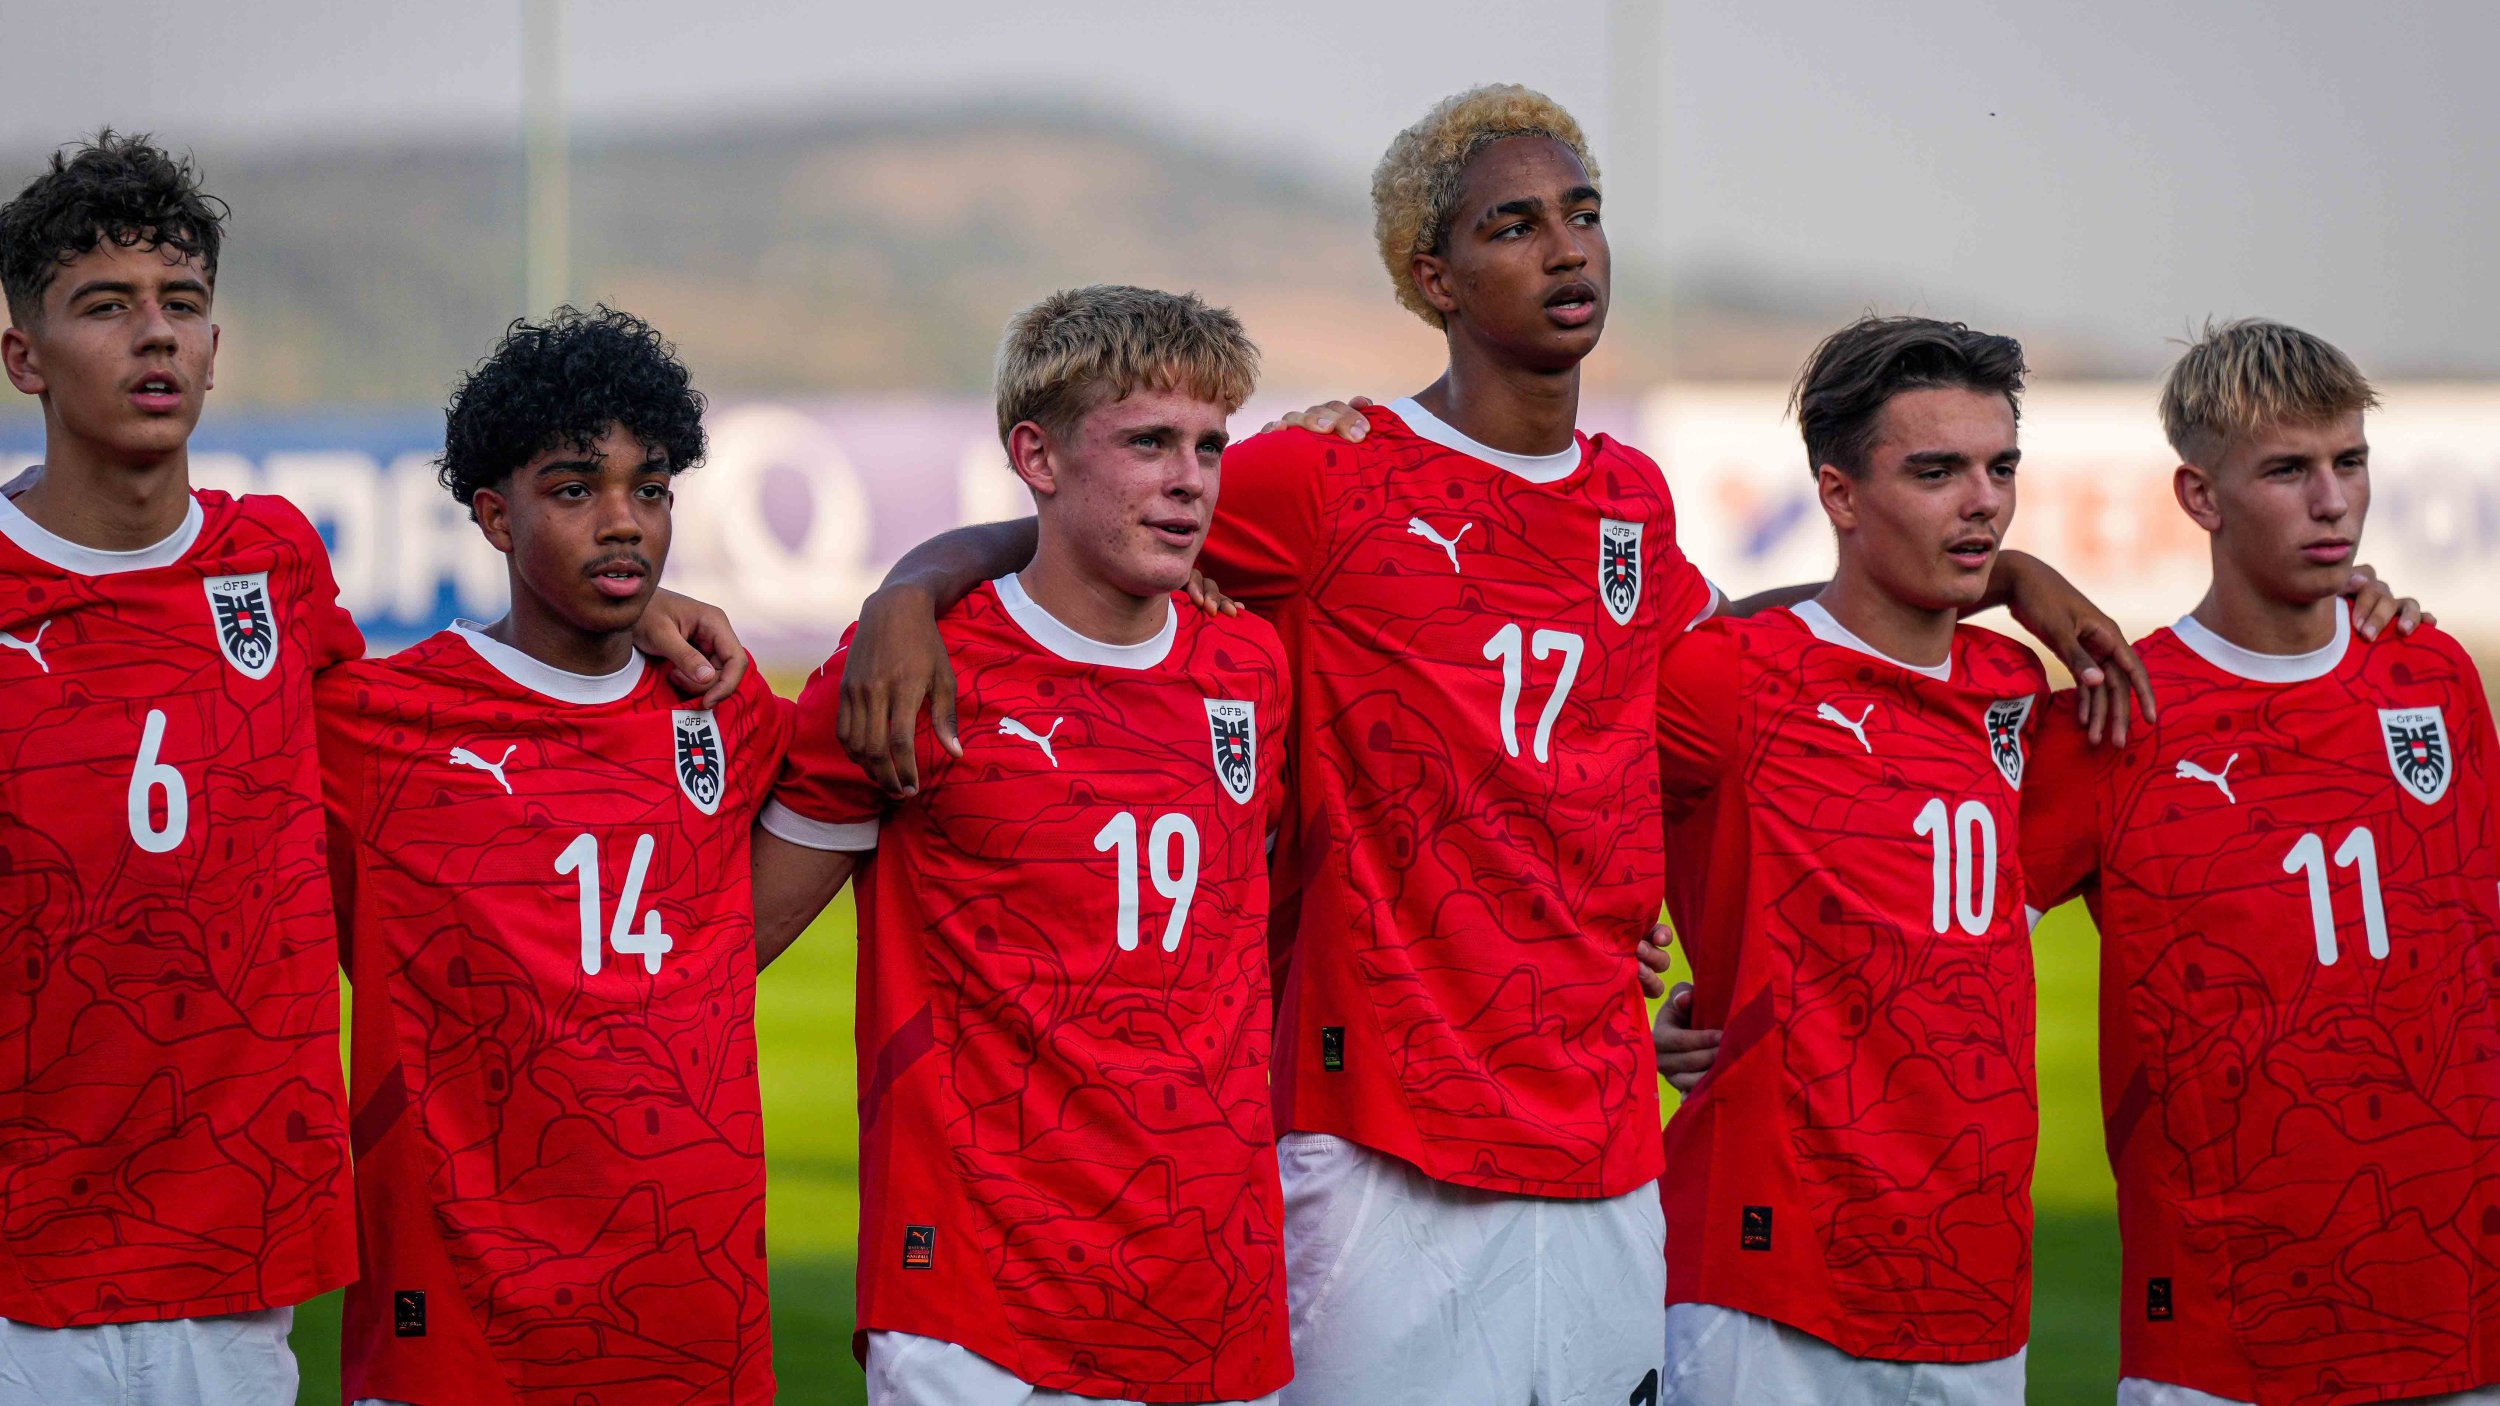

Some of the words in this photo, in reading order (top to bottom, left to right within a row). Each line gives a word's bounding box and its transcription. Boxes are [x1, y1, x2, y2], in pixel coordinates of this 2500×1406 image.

[223, 580, 249, 592] ÖFB
[684, 715, 701, 726] ÖFB
[1219, 705, 1242, 716] ÖFB
[1482, 622, 1585, 765] 17
[127, 709, 188, 853] 6
[554, 832, 673, 976] 14
[1093, 811, 1200, 953] 19
[1912, 797, 1997, 937] 10
[2282, 825, 2390, 967] 11
